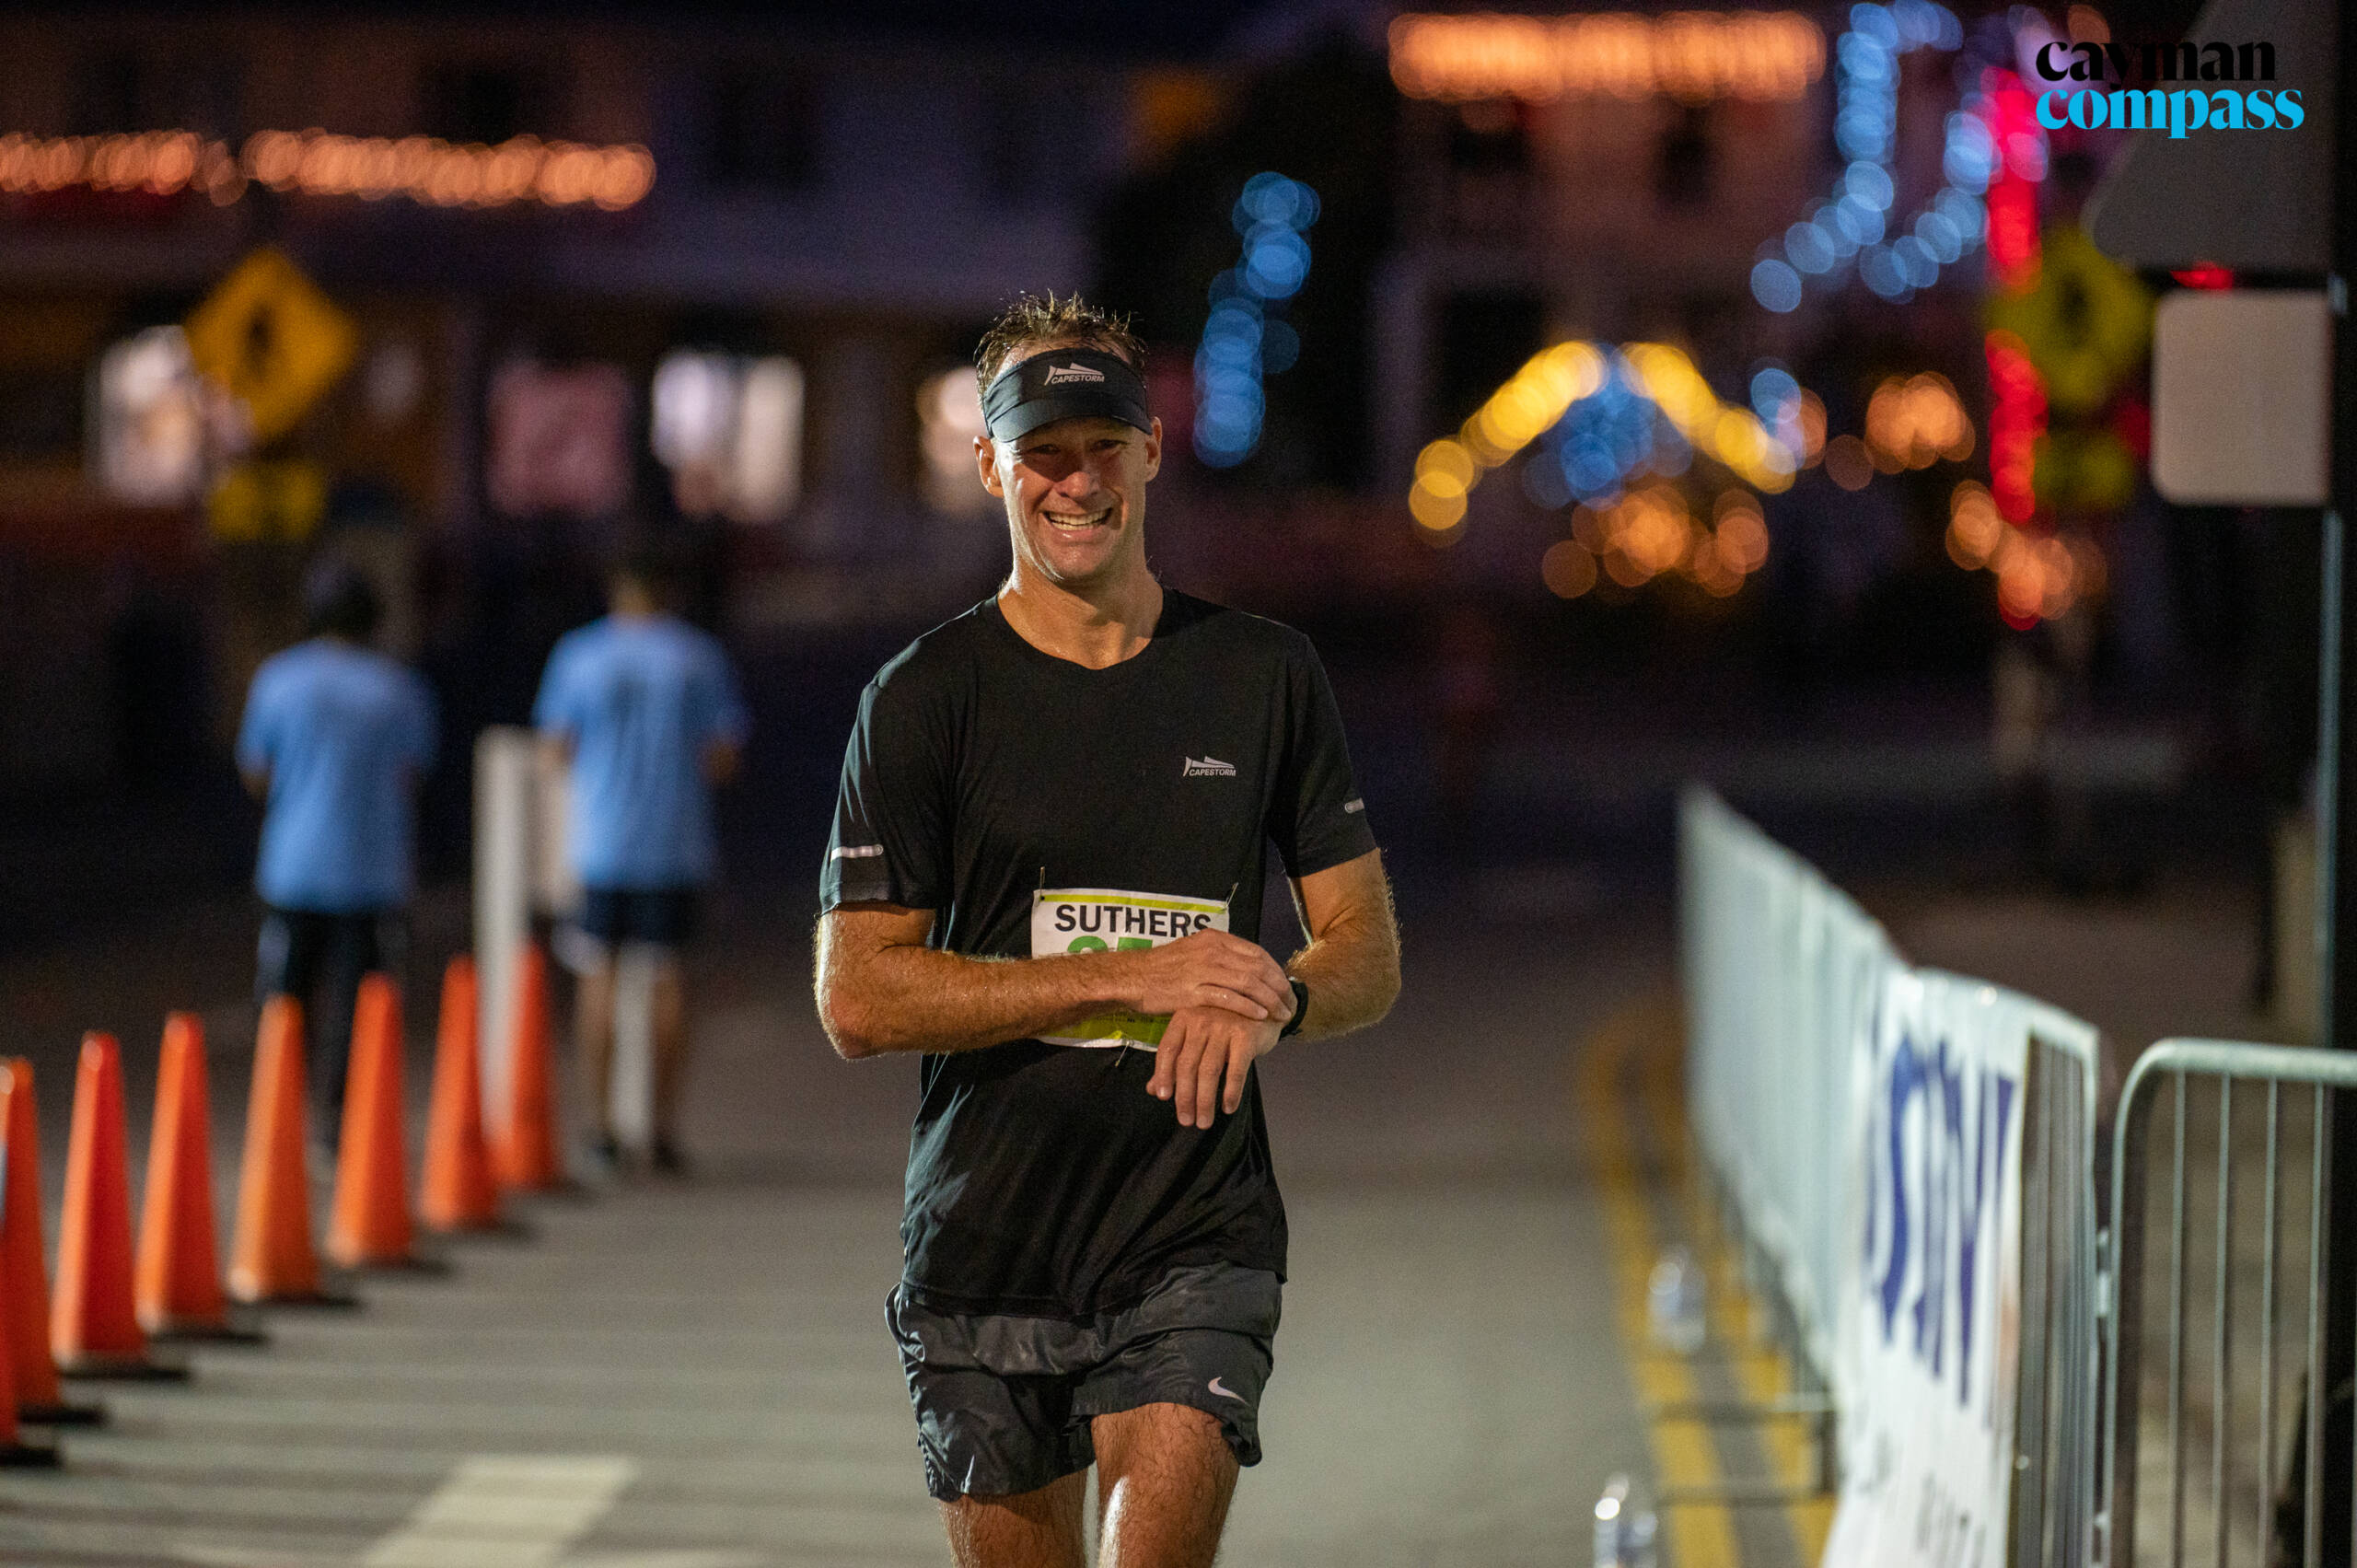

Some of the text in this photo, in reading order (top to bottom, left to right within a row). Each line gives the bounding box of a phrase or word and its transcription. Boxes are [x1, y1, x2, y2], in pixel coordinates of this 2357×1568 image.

[1051, 374, 1105, 384] CAPESTORM
[1189, 768, 1236, 776] CAPESTORM
[1054, 904, 1212, 937] SUTHERS
